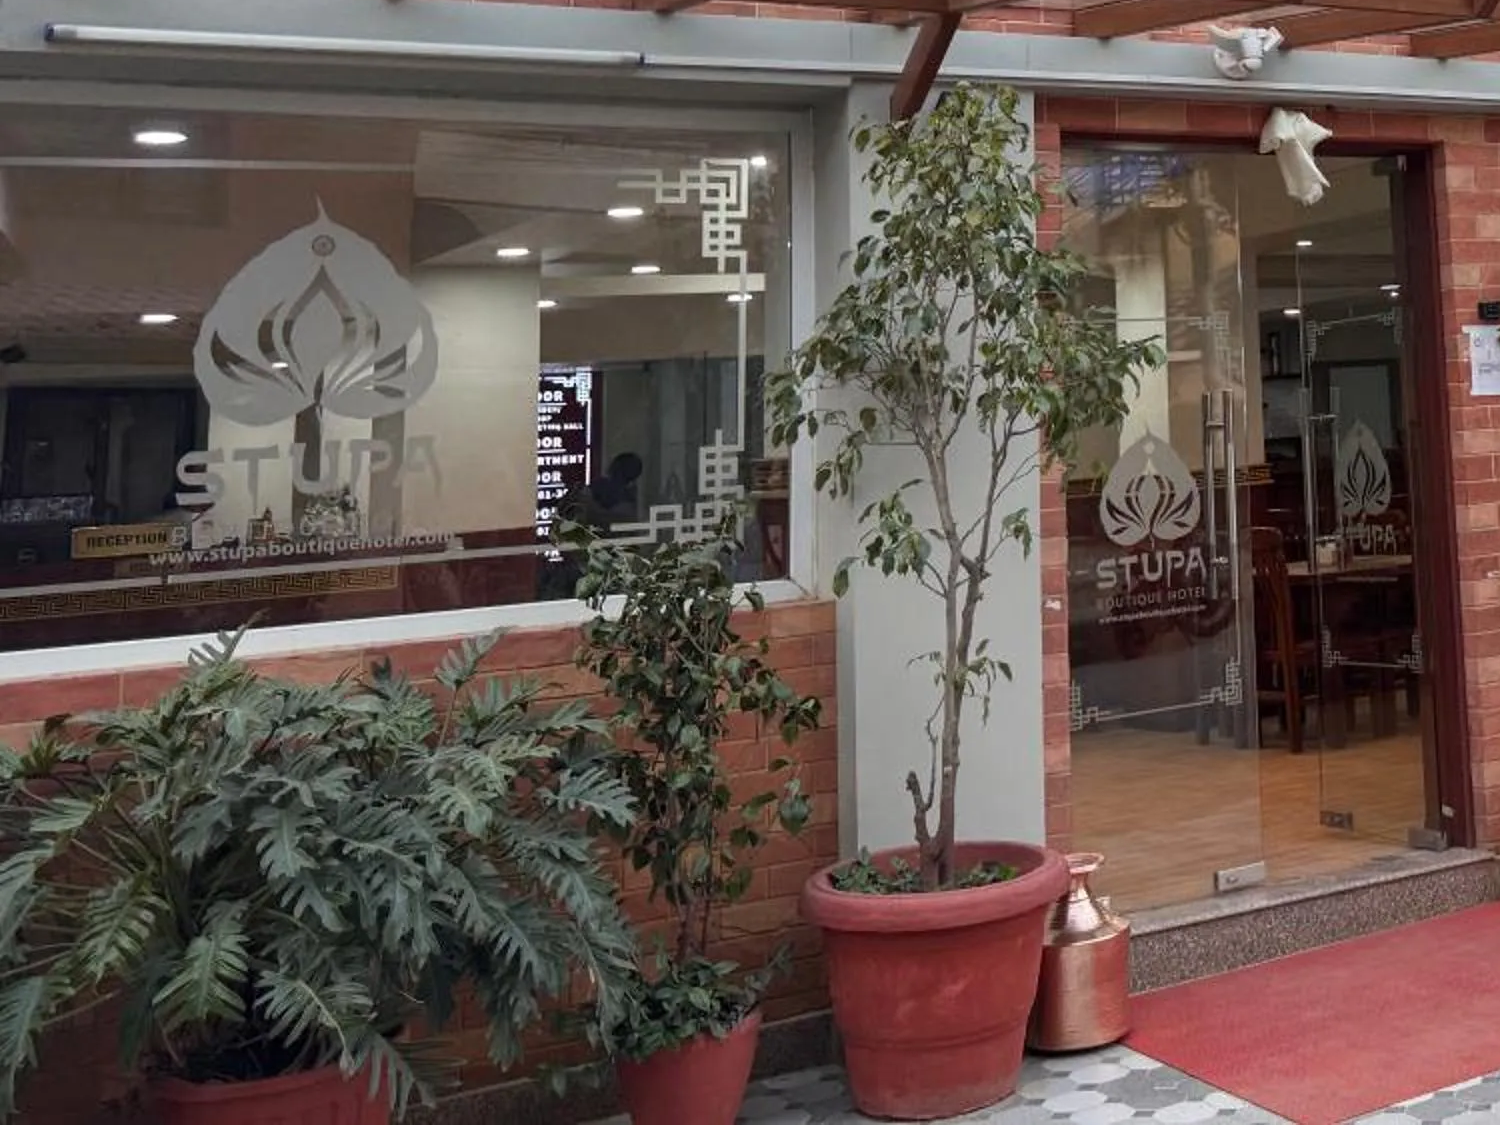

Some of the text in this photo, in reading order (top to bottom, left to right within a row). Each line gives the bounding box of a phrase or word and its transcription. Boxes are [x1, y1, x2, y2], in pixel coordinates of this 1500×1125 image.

[175, 435, 442, 513] STUPA
[86, 531, 168, 549] RECEPTION
[1096, 547, 1207, 592] STUPA
